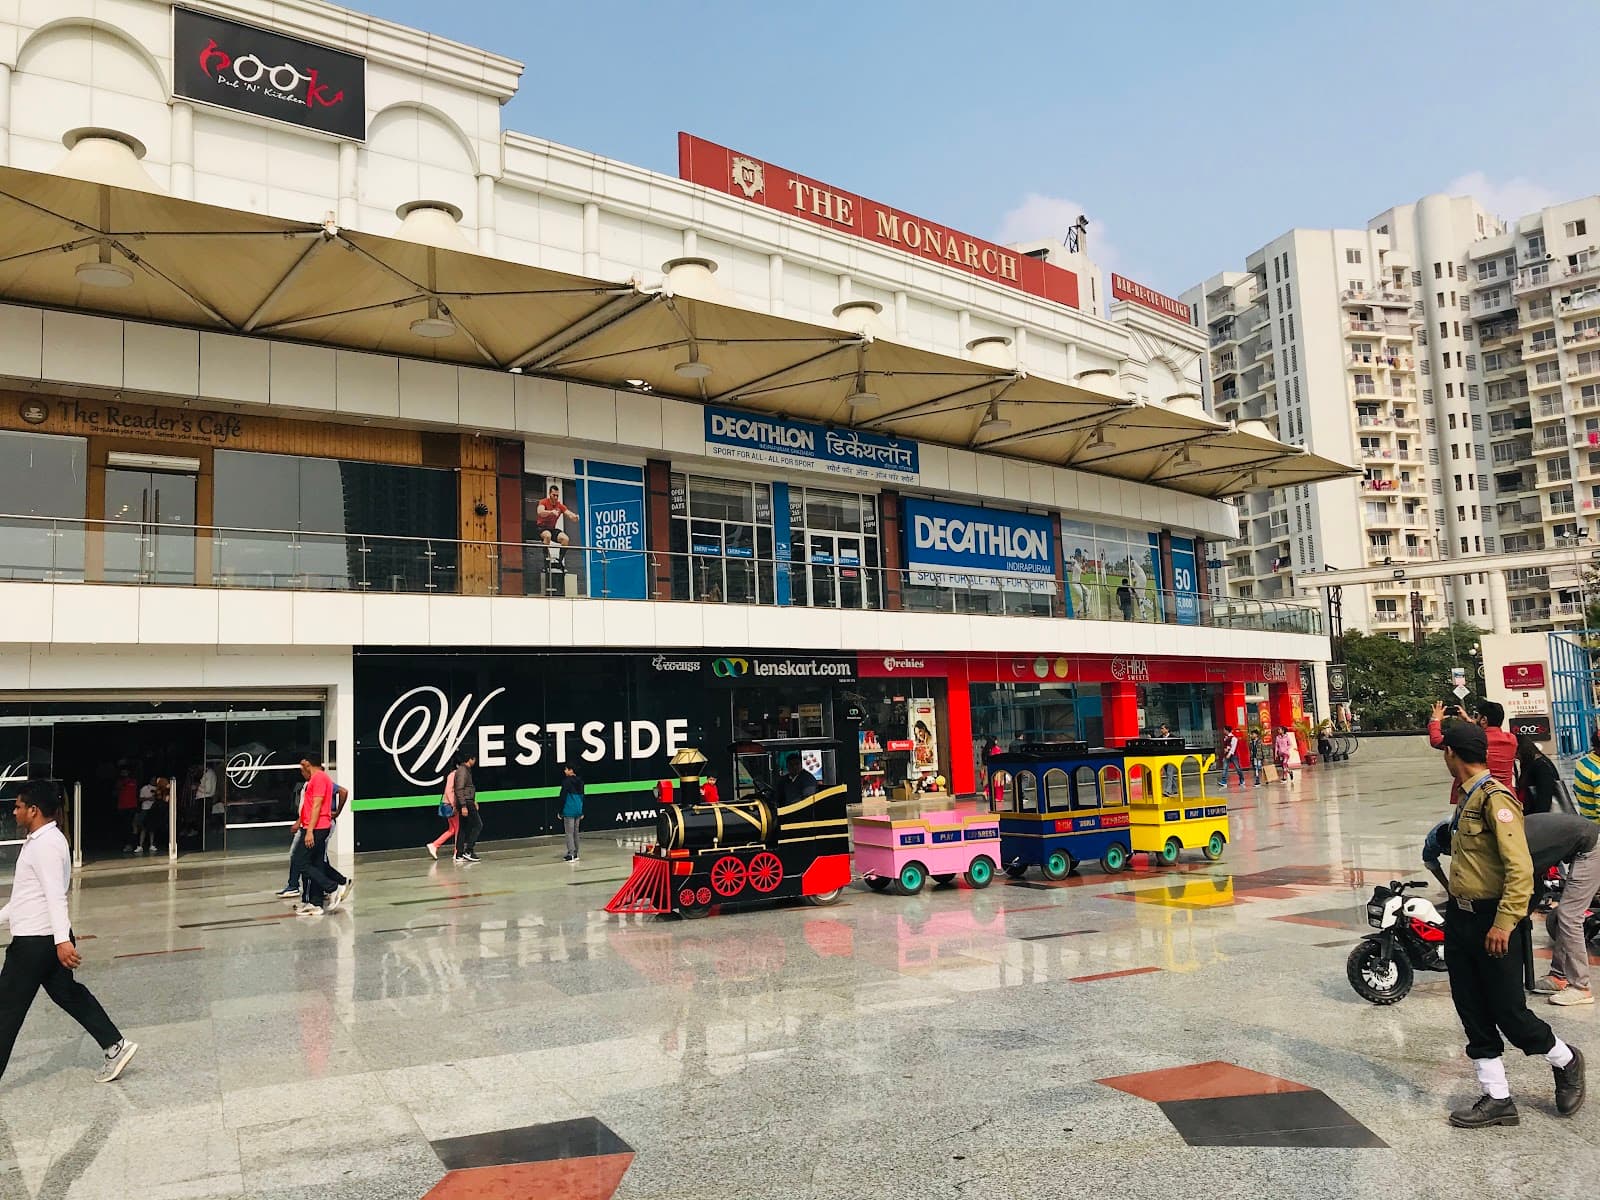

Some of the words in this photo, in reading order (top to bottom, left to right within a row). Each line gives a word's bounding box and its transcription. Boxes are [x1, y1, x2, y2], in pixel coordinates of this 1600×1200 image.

[217, 74, 240, 89] Pub
[264, 87, 307, 105] Kitchen
[788, 178, 854, 227] THE
[875, 208, 1018, 282] MONARCH
[57, 400, 99, 424] The
[106, 406, 192, 433] Reader's
[197, 414, 243, 443] Café
[711, 414, 815, 451] DECATHLON
[712, 446, 736, 457] SPORT
[737, 450, 750, 459] FOR
[751, 452, 764, 461] ALL
[768, 455, 780, 463] ALL
[781, 457, 794, 466] FOR
[795, 459, 815, 469] SPORT
[595, 509, 626, 525] YOUR
[595, 521, 639, 541] SPORTS
[914, 514, 1048, 561] DECATHLON
[595, 536, 632, 553] STORE
[1006, 562, 1051, 573] INDIRAPURAM
[1175, 568, 1191, 590] 50
[753, 659, 852, 677] lenskart.com
[1126, 656, 1148, 675] HIRA
[378, 685, 689, 787] WESTSIDE
[615, 812, 624, 822] A
[624, 809, 657, 821] TATA
